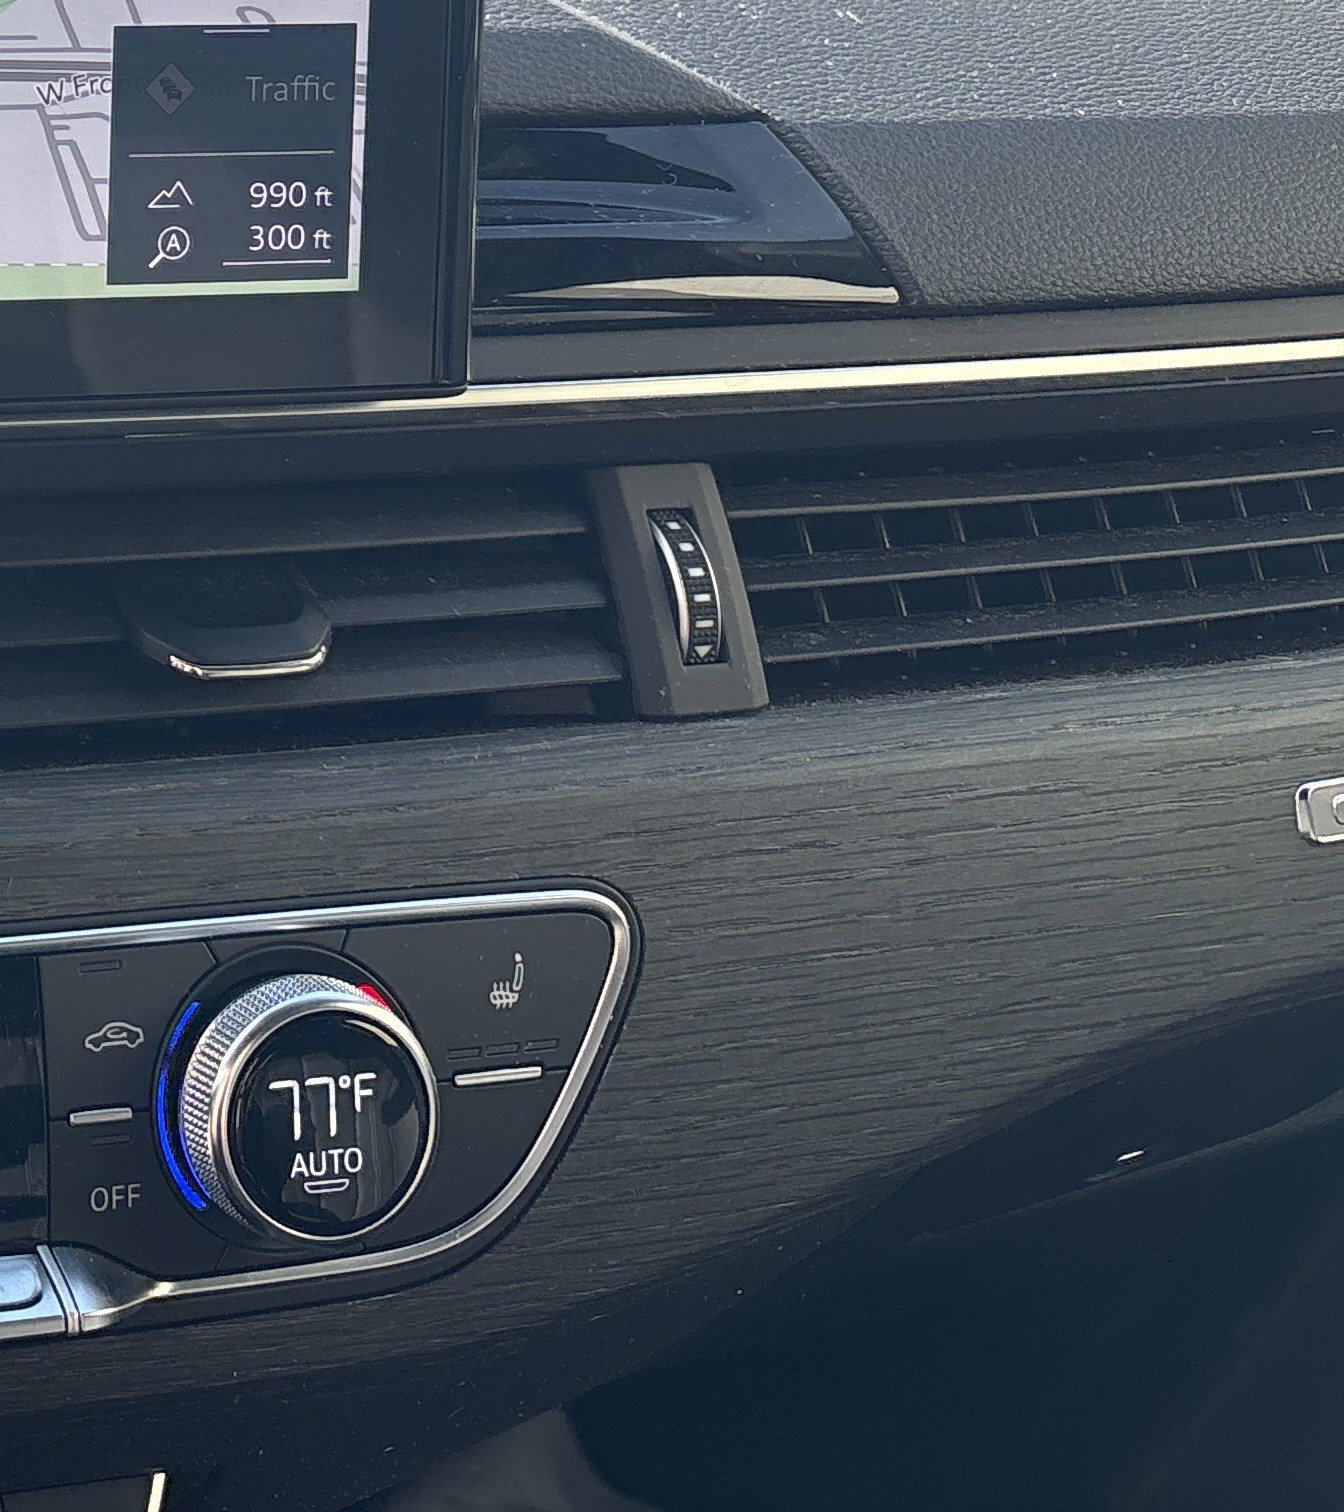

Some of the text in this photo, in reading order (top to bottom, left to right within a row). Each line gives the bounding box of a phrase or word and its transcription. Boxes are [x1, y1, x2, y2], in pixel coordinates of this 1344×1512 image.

[36, 78, 64, 106] W
[245, 75, 336, 102] Traffic
[249, 181, 333, 208] 990 ft
[248, 224, 332, 251] 300 ft
[289, 1147, 364, 1179] AUTO
[90, 1184, 142, 1212] OFF
